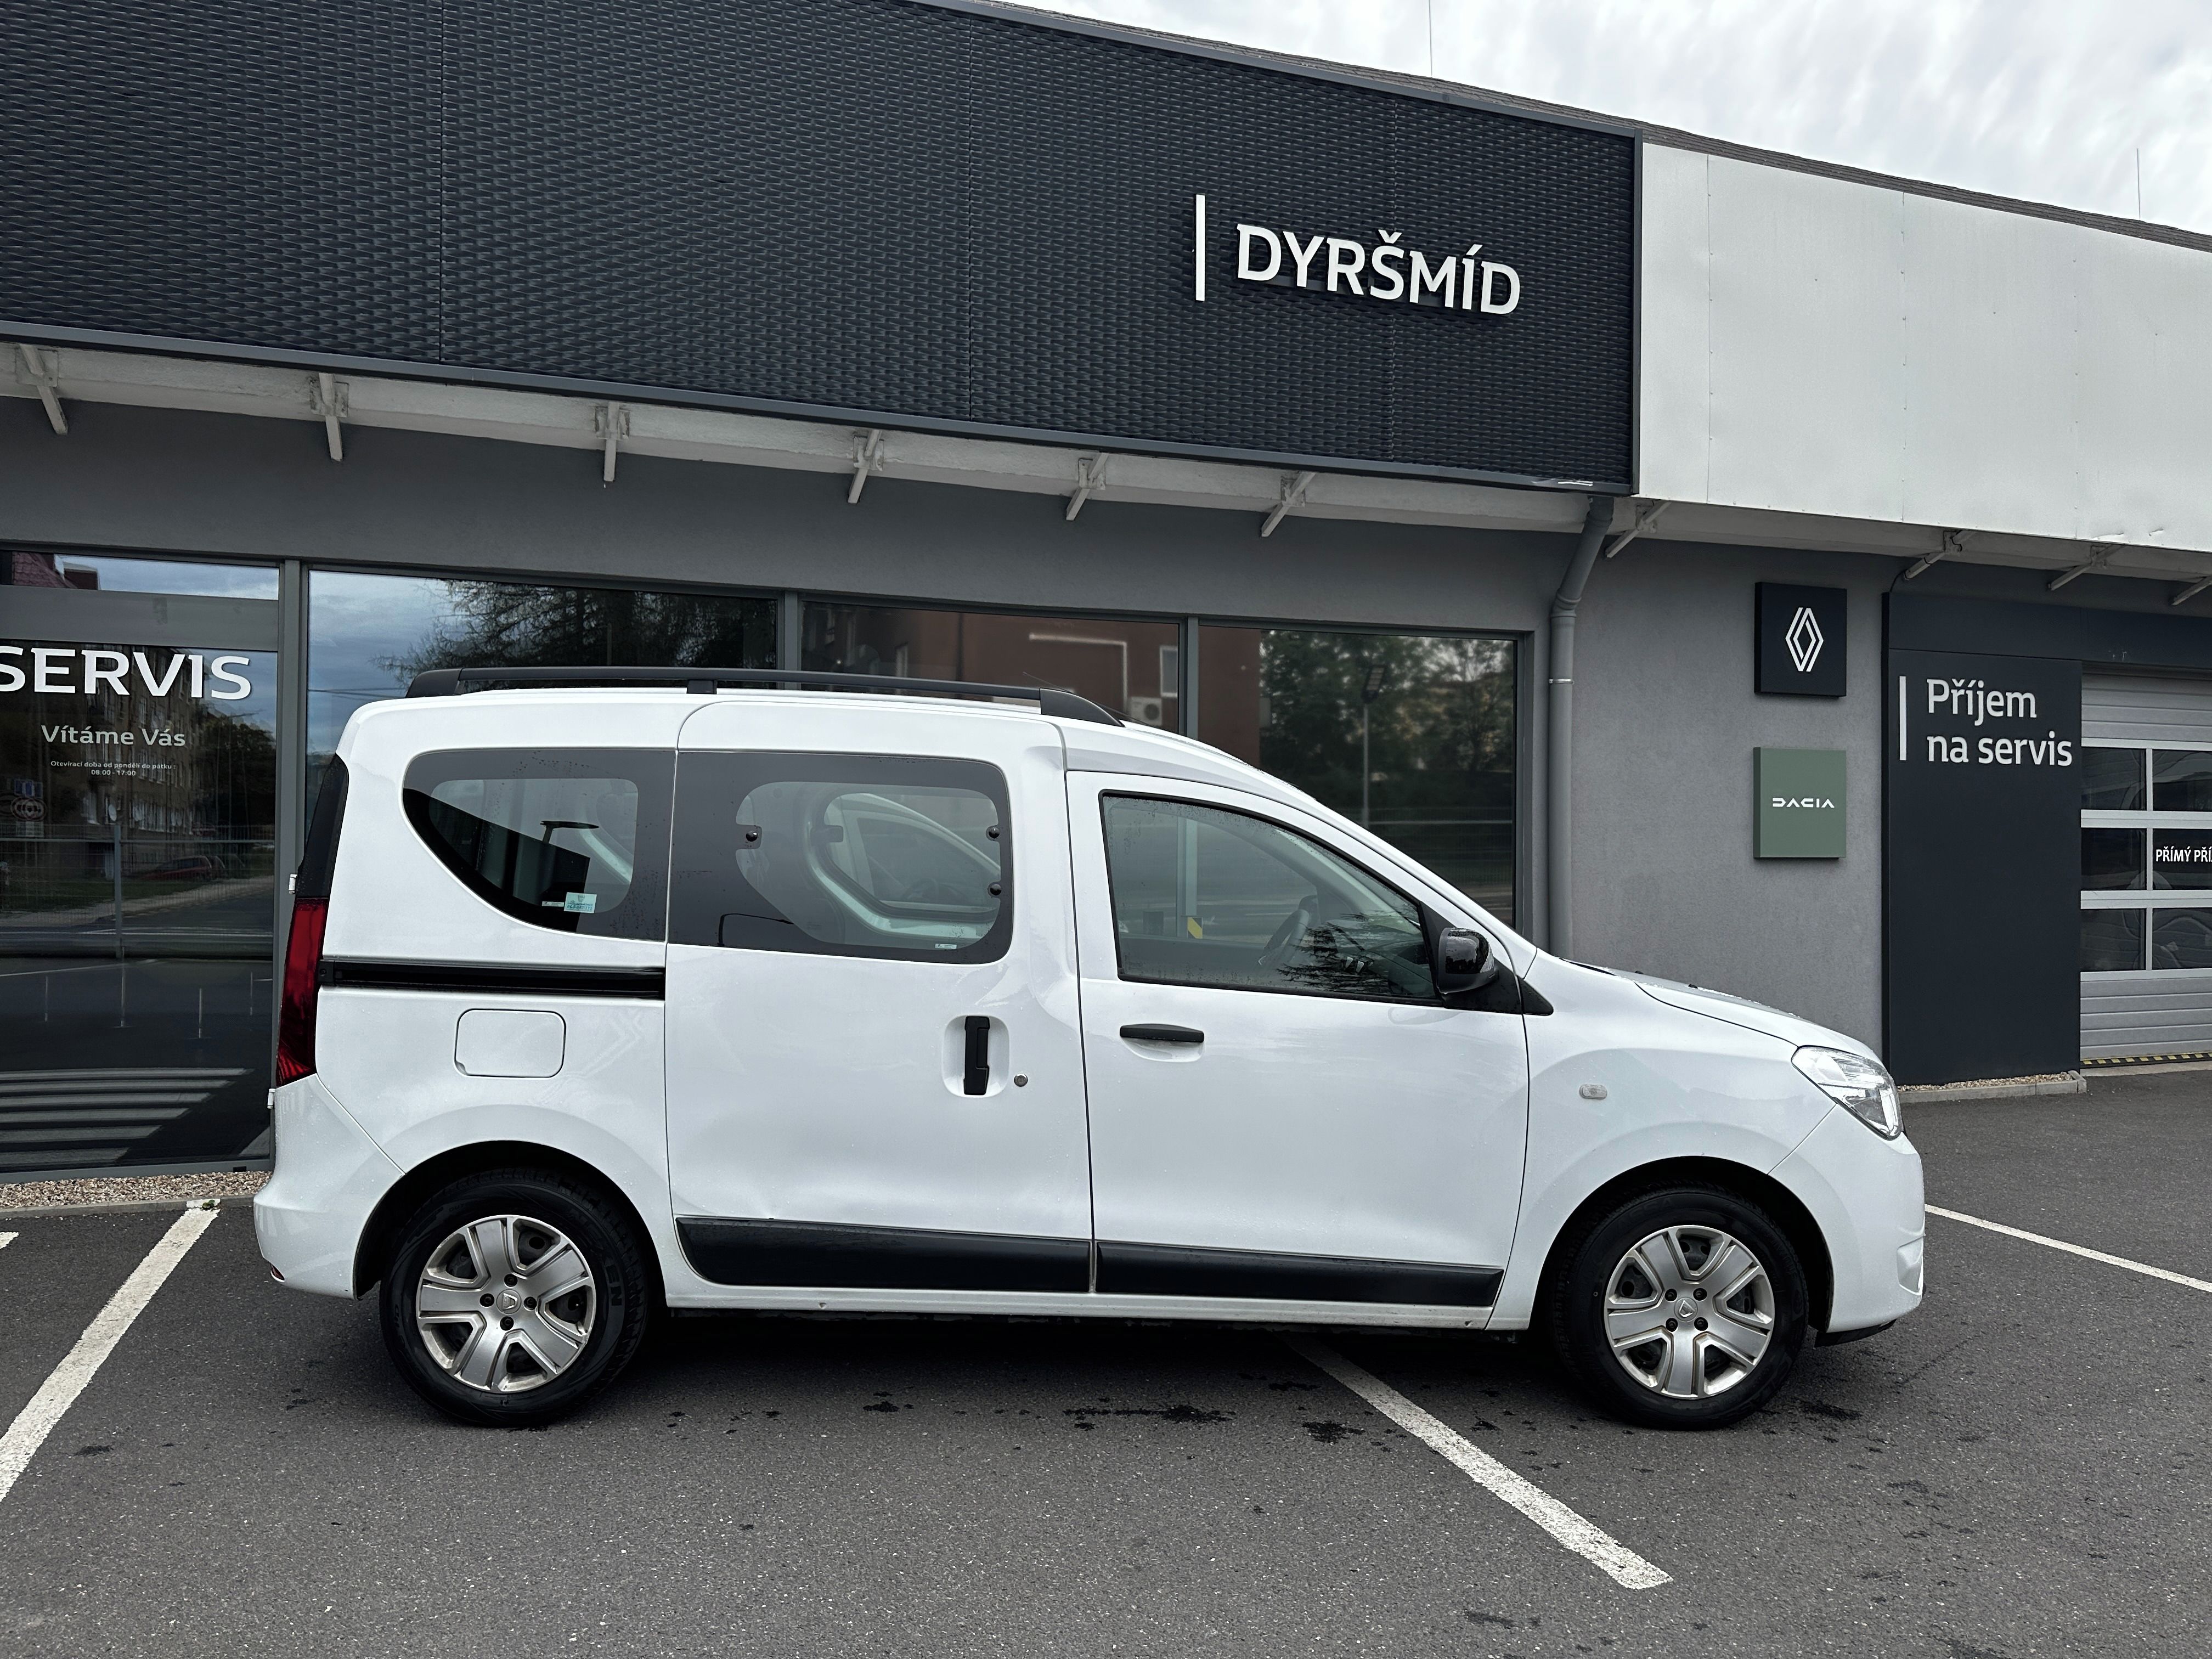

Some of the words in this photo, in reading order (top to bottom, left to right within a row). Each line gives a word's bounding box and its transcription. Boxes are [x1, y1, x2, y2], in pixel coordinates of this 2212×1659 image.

[1237, 224, 1520, 314] DYRŠMÍD
[0, 646, 251, 700] SERVIS
[1927, 678, 2037, 726] Příjem
[41, 725, 134, 745] Vítáme
[141, 728, 185, 747] Vás
[1927, 736, 1969, 763] na
[1978, 731, 2073, 766] servis
[114, 761, 140, 770] pondělí
[1772, 797, 1835, 809] DACIA
[2155, 845, 2192, 862] PŘÍMÝ
[2194, 846, 2212, 862] PŘÍ
